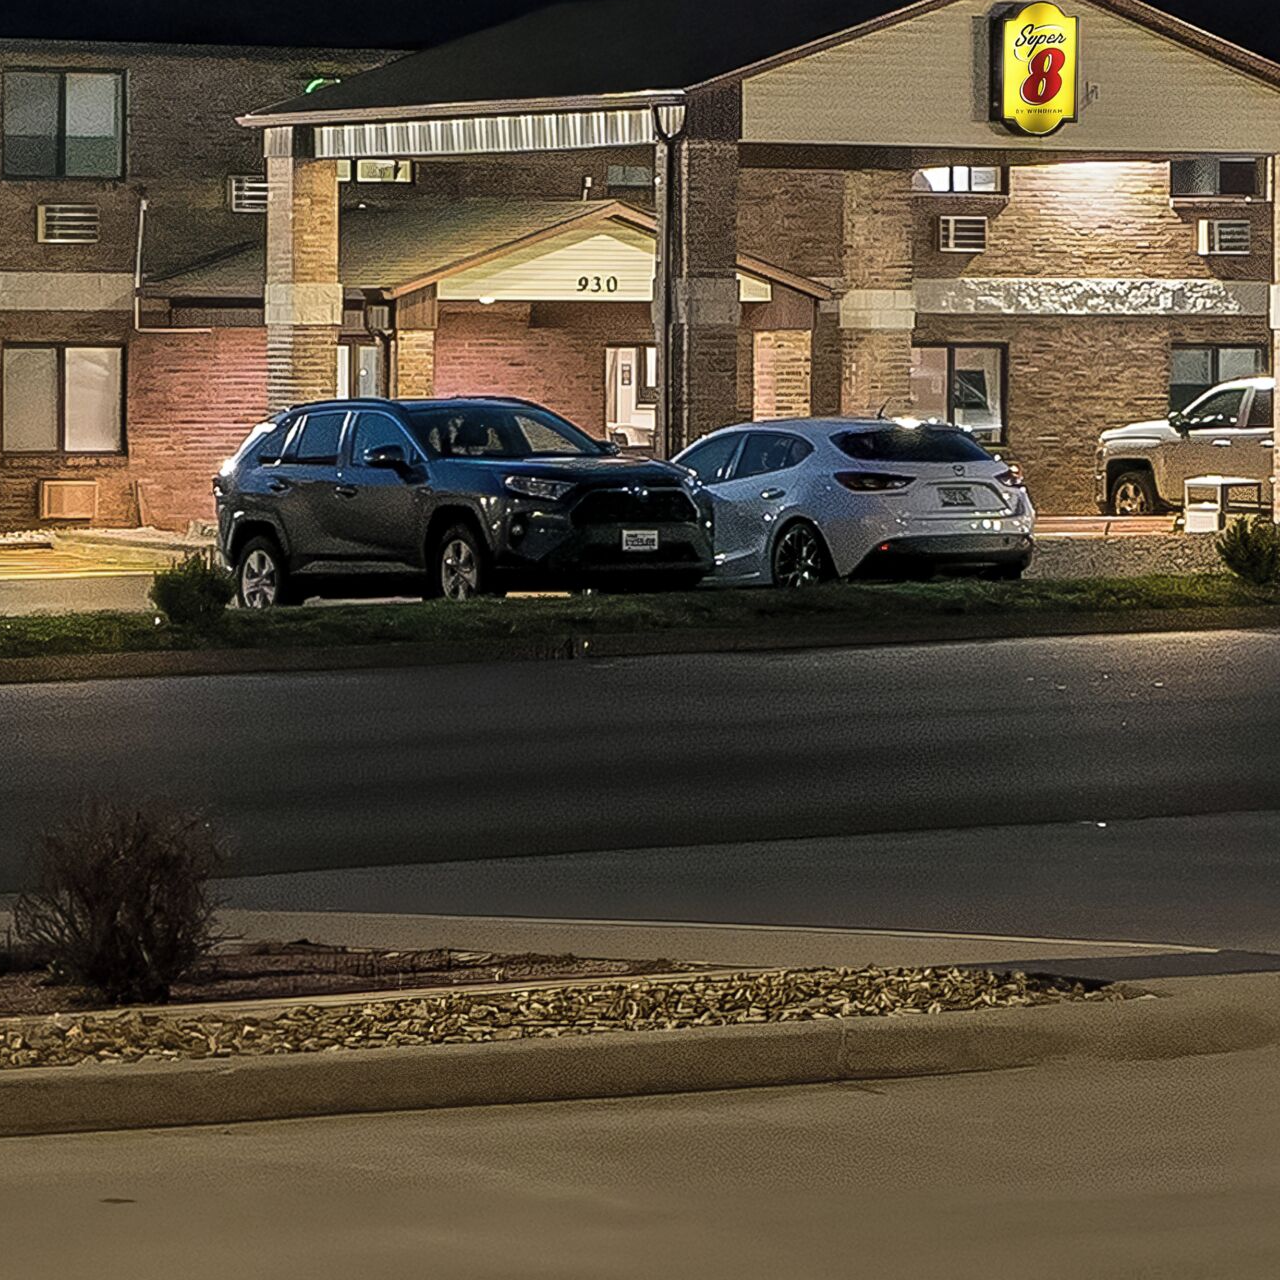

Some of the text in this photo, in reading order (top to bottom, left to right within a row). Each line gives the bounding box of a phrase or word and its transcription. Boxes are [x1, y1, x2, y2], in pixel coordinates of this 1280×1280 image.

[1014, 23, 1067, 58] Super
[1019, 47, 1066, 106] 8
[576, 276, 618, 292] 930
